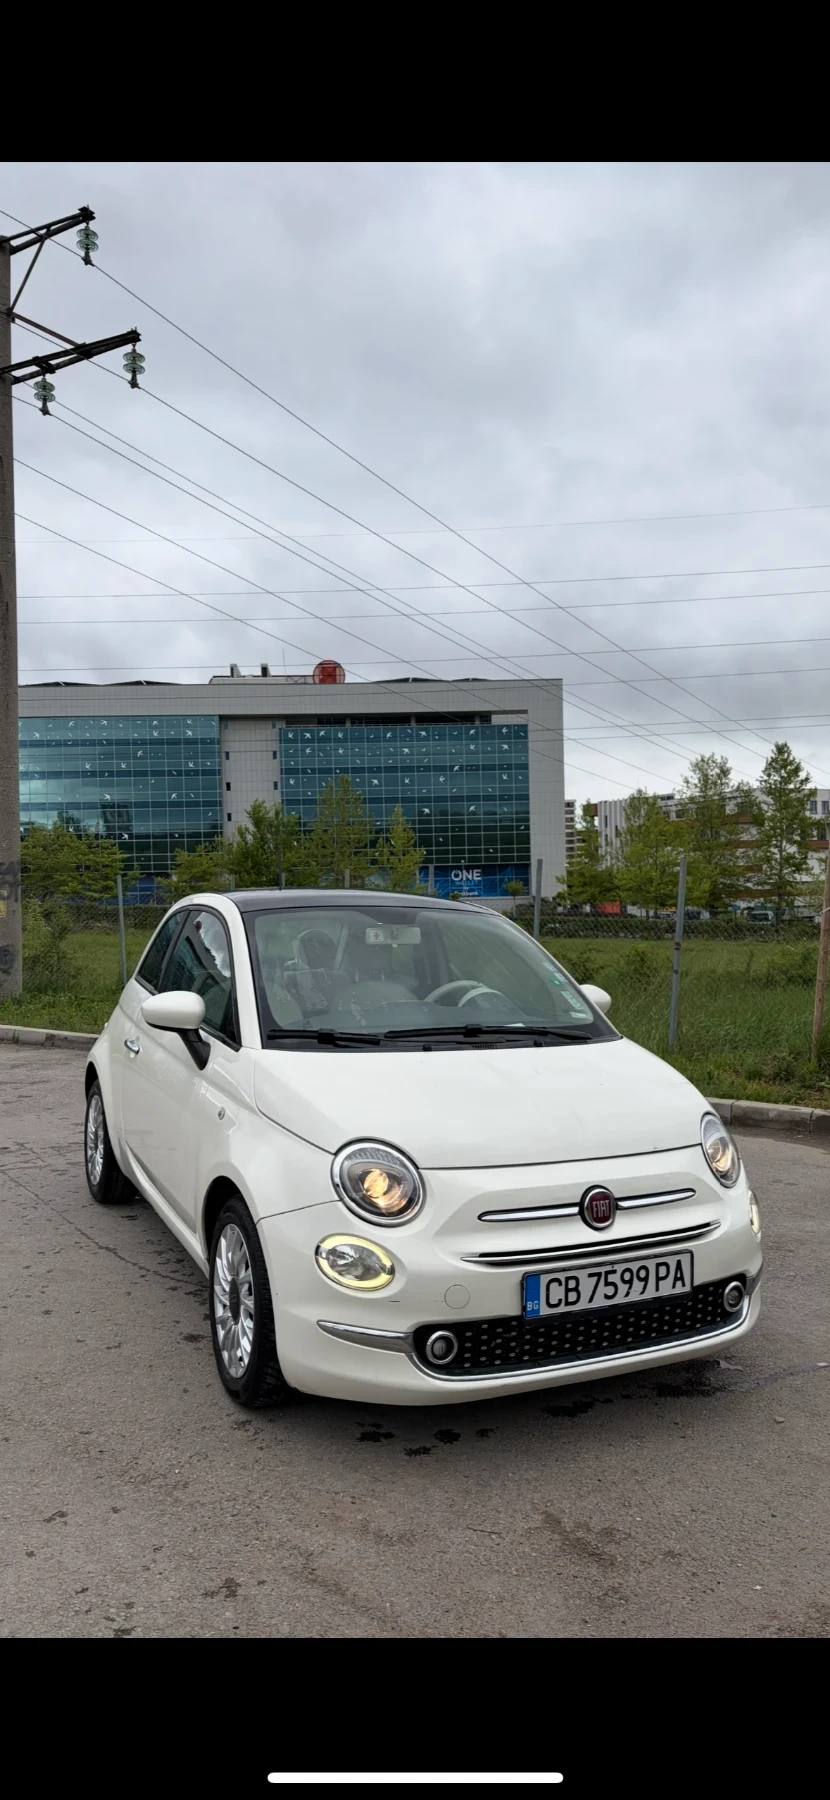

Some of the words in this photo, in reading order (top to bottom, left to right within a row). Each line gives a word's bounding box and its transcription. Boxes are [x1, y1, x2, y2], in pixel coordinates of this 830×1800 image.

[451, 869, 482, 881] ONE
[592, 1200, 610, 1218] FIAT
[545, 1275, 581, 1309] CB
[587, 1265, 650, 1304] 7599
[655, 1259, 686, 1293] PA
[526, 1301, 539, 1311] BG
